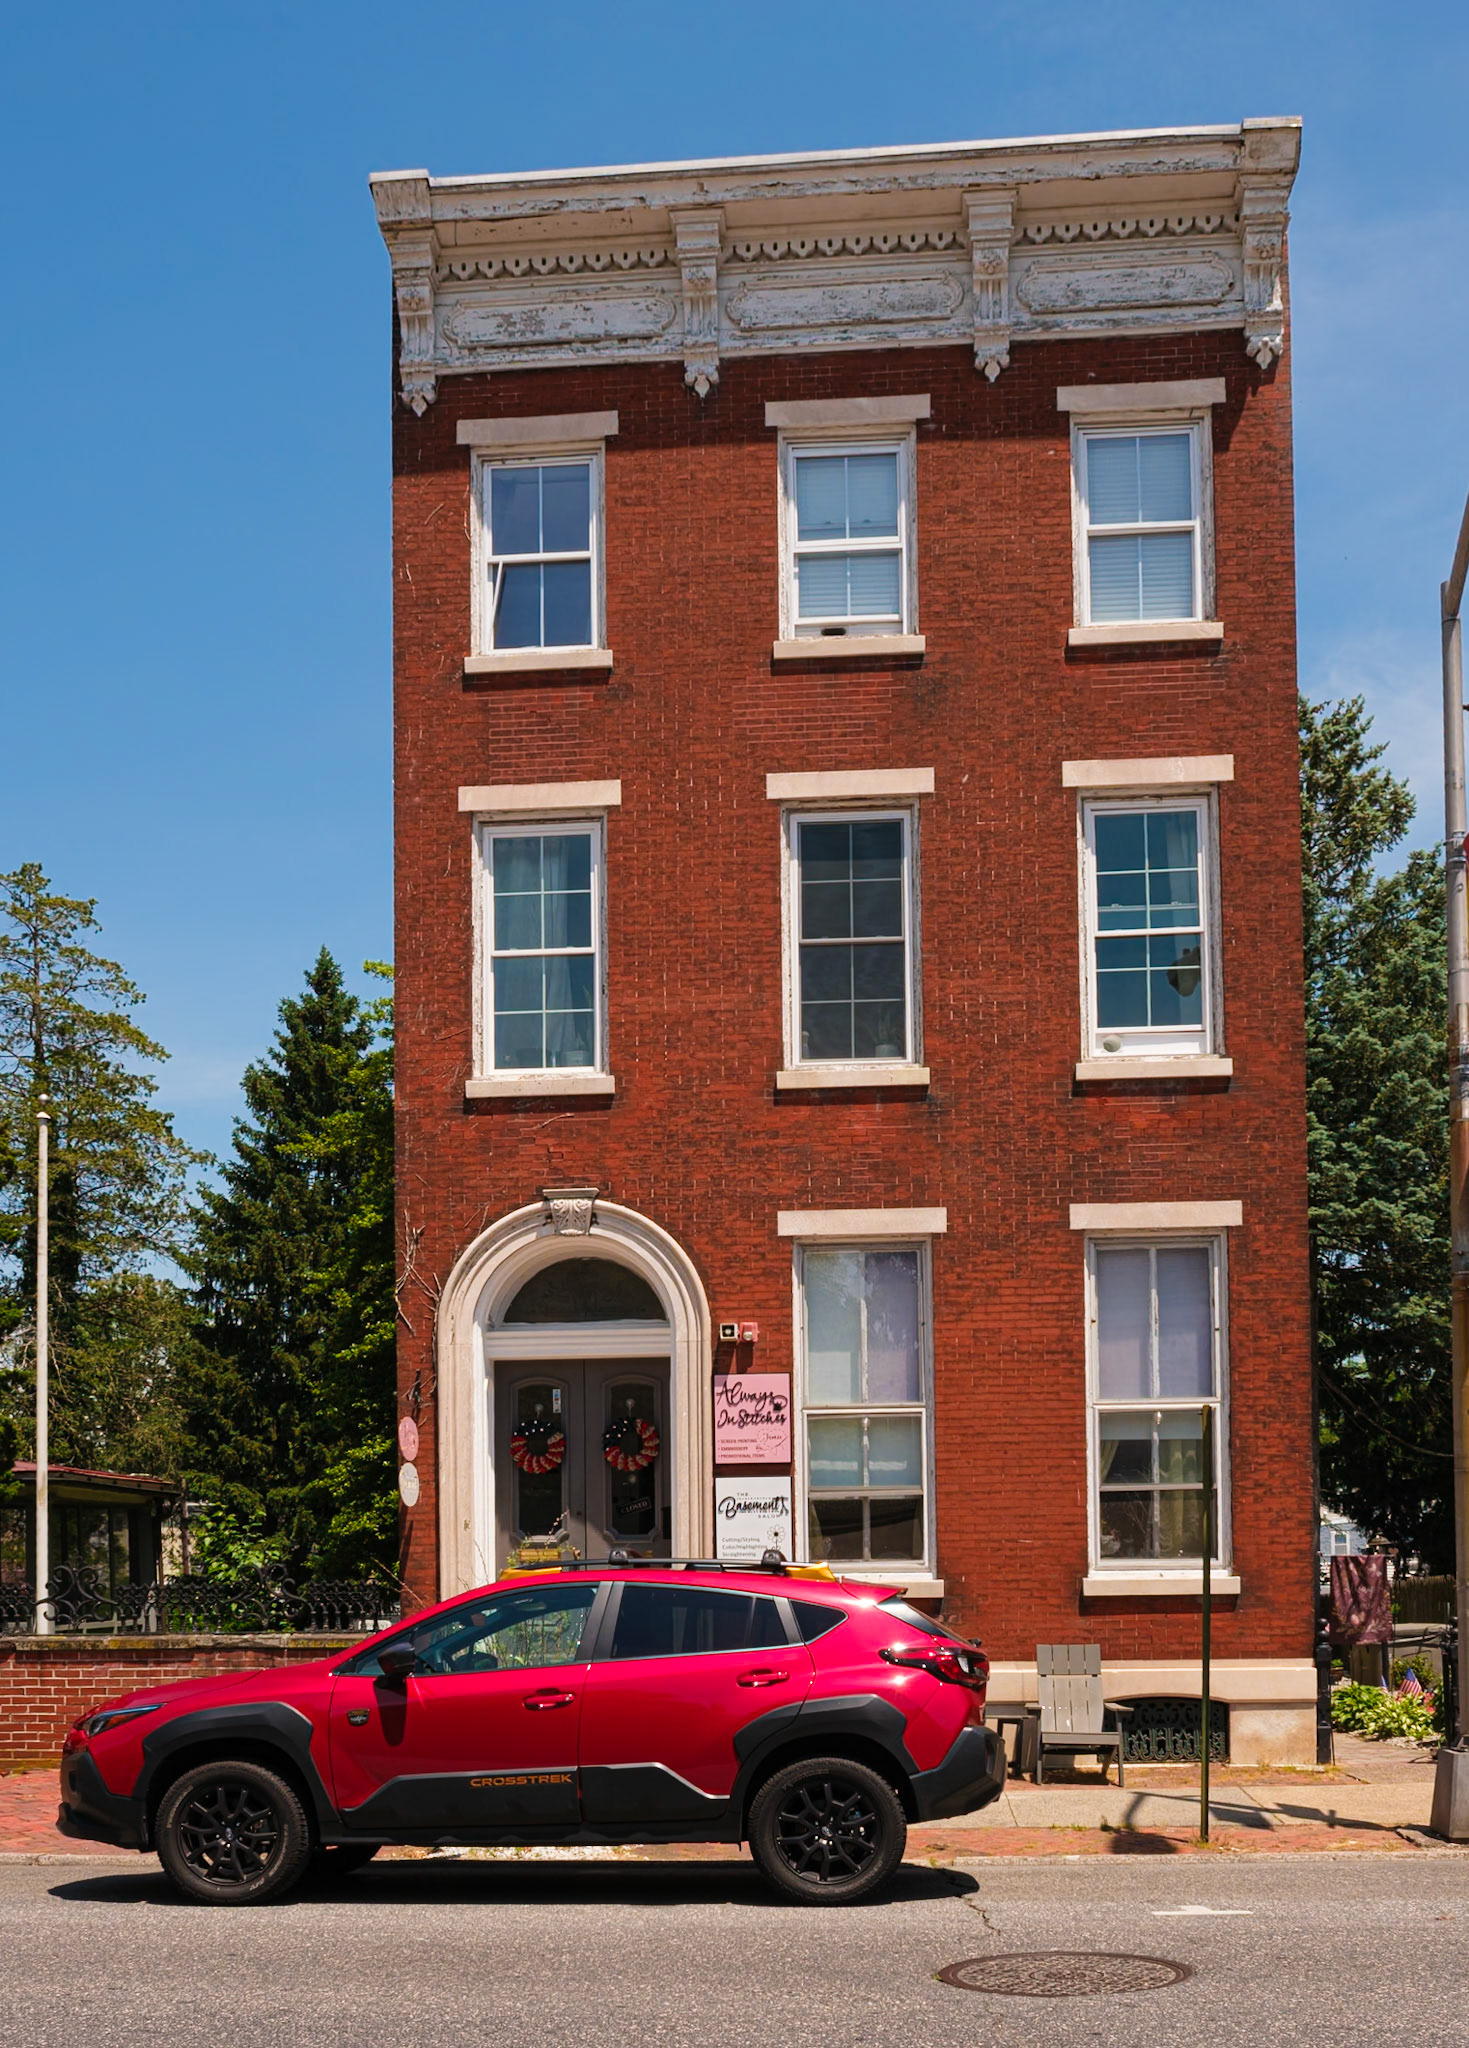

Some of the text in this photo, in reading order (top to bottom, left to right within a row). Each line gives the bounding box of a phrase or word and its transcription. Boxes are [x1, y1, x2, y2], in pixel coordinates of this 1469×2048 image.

[716, 1381, 775, 1412] Always
[738, 1409, 787, 1429] Stitches
[621, 1501, 648, 1513] CLOSED
[718, 1496, 781, 1519] Basement
[470, 1773, 573, 1788] CROSSTREK
